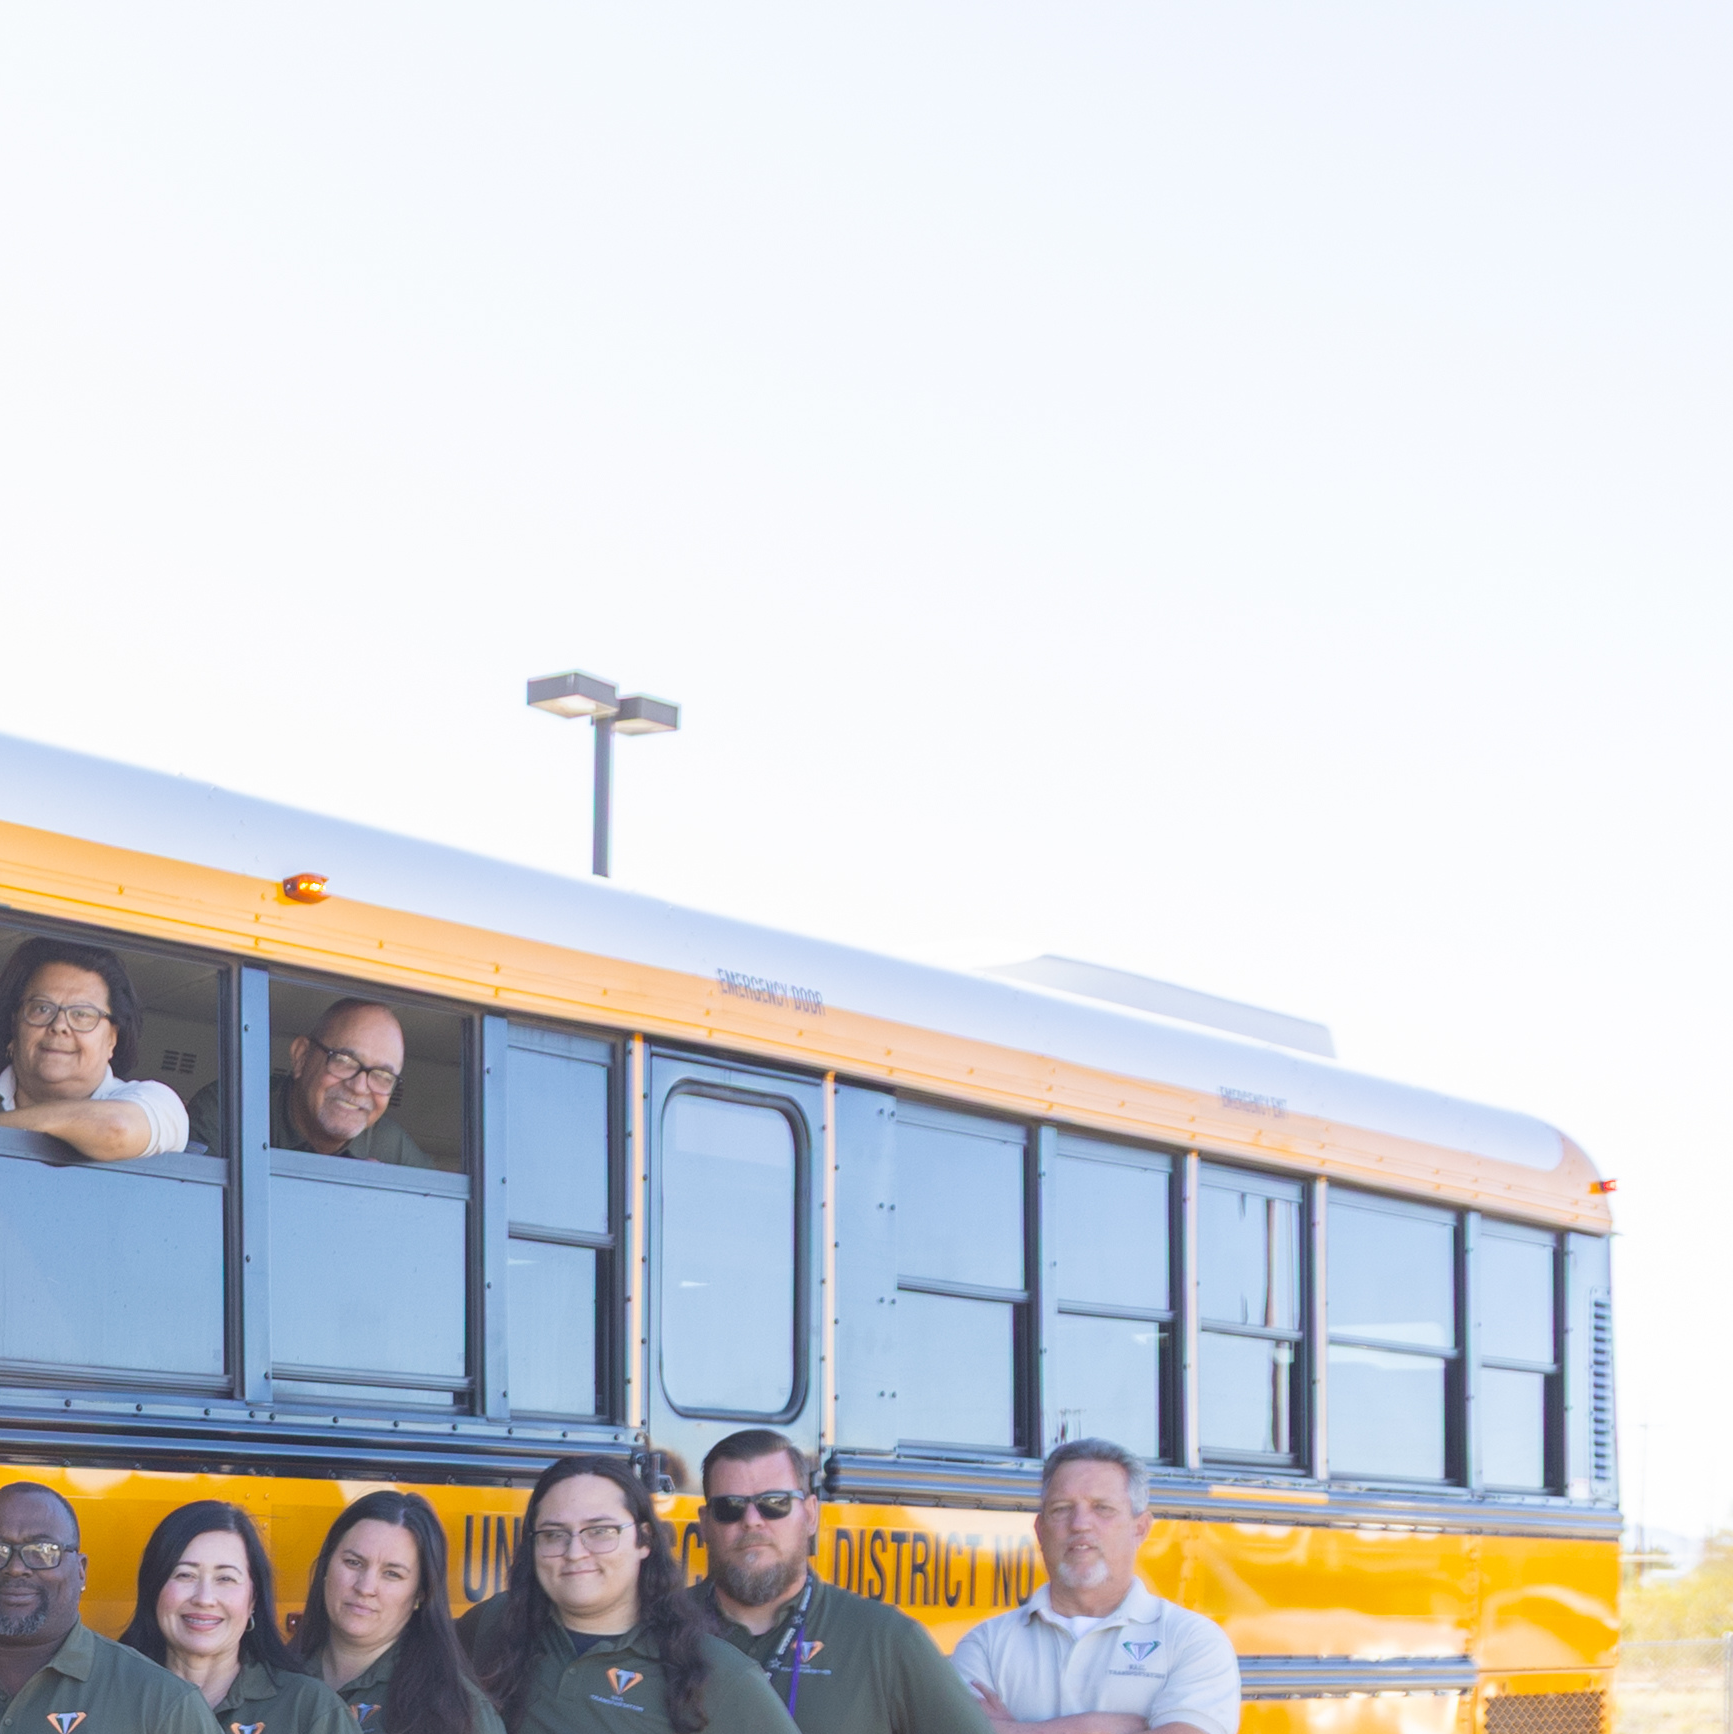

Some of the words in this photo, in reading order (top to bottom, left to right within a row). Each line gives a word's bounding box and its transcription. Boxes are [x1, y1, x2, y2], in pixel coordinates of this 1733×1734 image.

[716, 967, 790, 1008] EMERGENCY
[790, 984, 826, 1017] DOOR
[833, 1527, 984, 1608] DISTRICT
